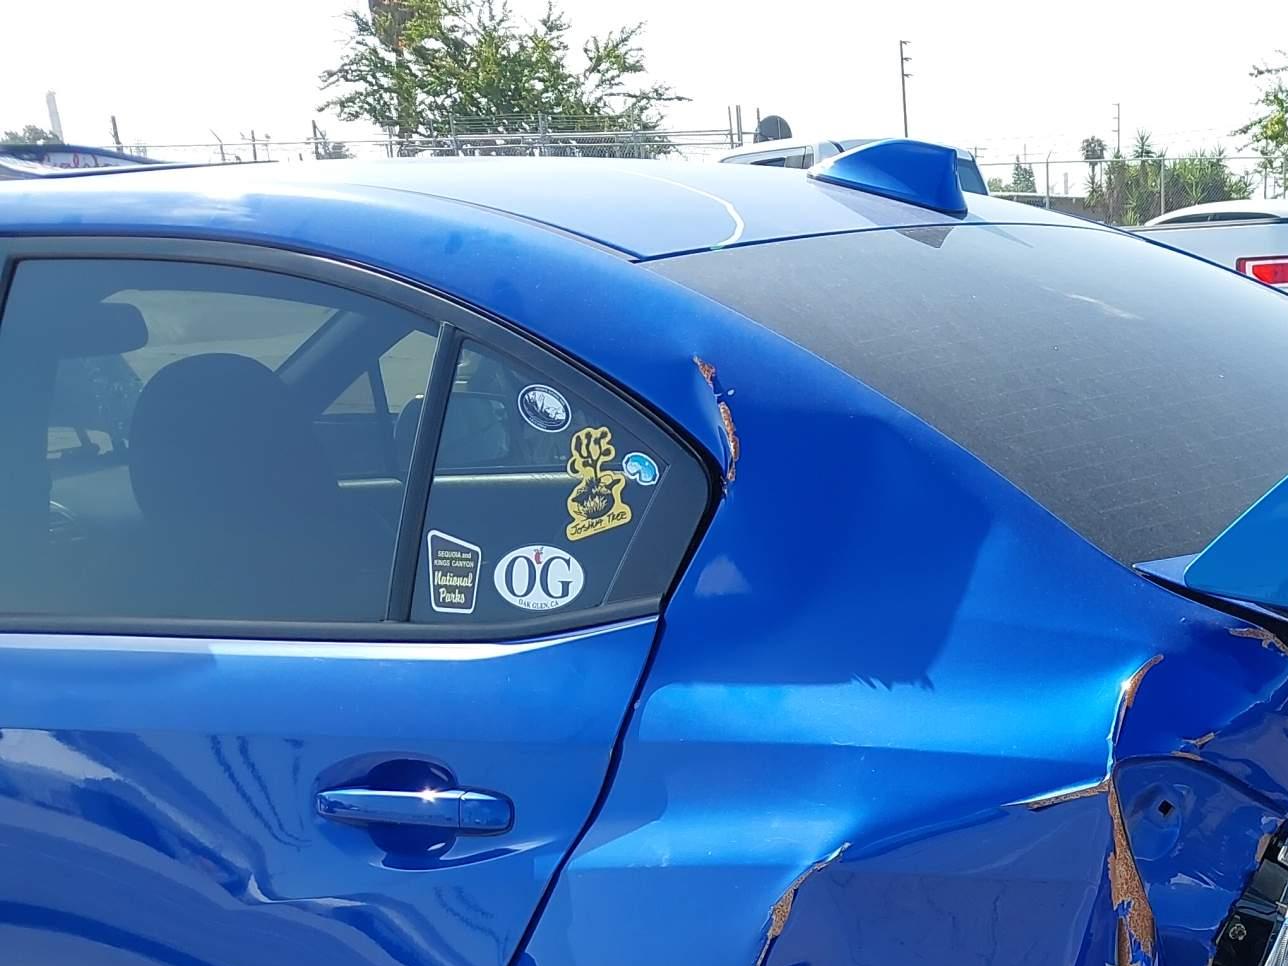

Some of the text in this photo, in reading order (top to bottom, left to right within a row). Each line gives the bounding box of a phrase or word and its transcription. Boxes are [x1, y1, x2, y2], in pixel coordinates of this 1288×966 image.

[570, 519, 604, 536] JOSHUA
[438, 550, 471, 559] SEQUOIA and
[434, 559, 474, 568] KINGS CANYON
[434, 570, 473, 588] National
[504, 555, 573, 599] OG
[439, 587, 465, 604] Parks
[518, 598, 530, 608] OAK
[550, 599, 559, 608] CA
